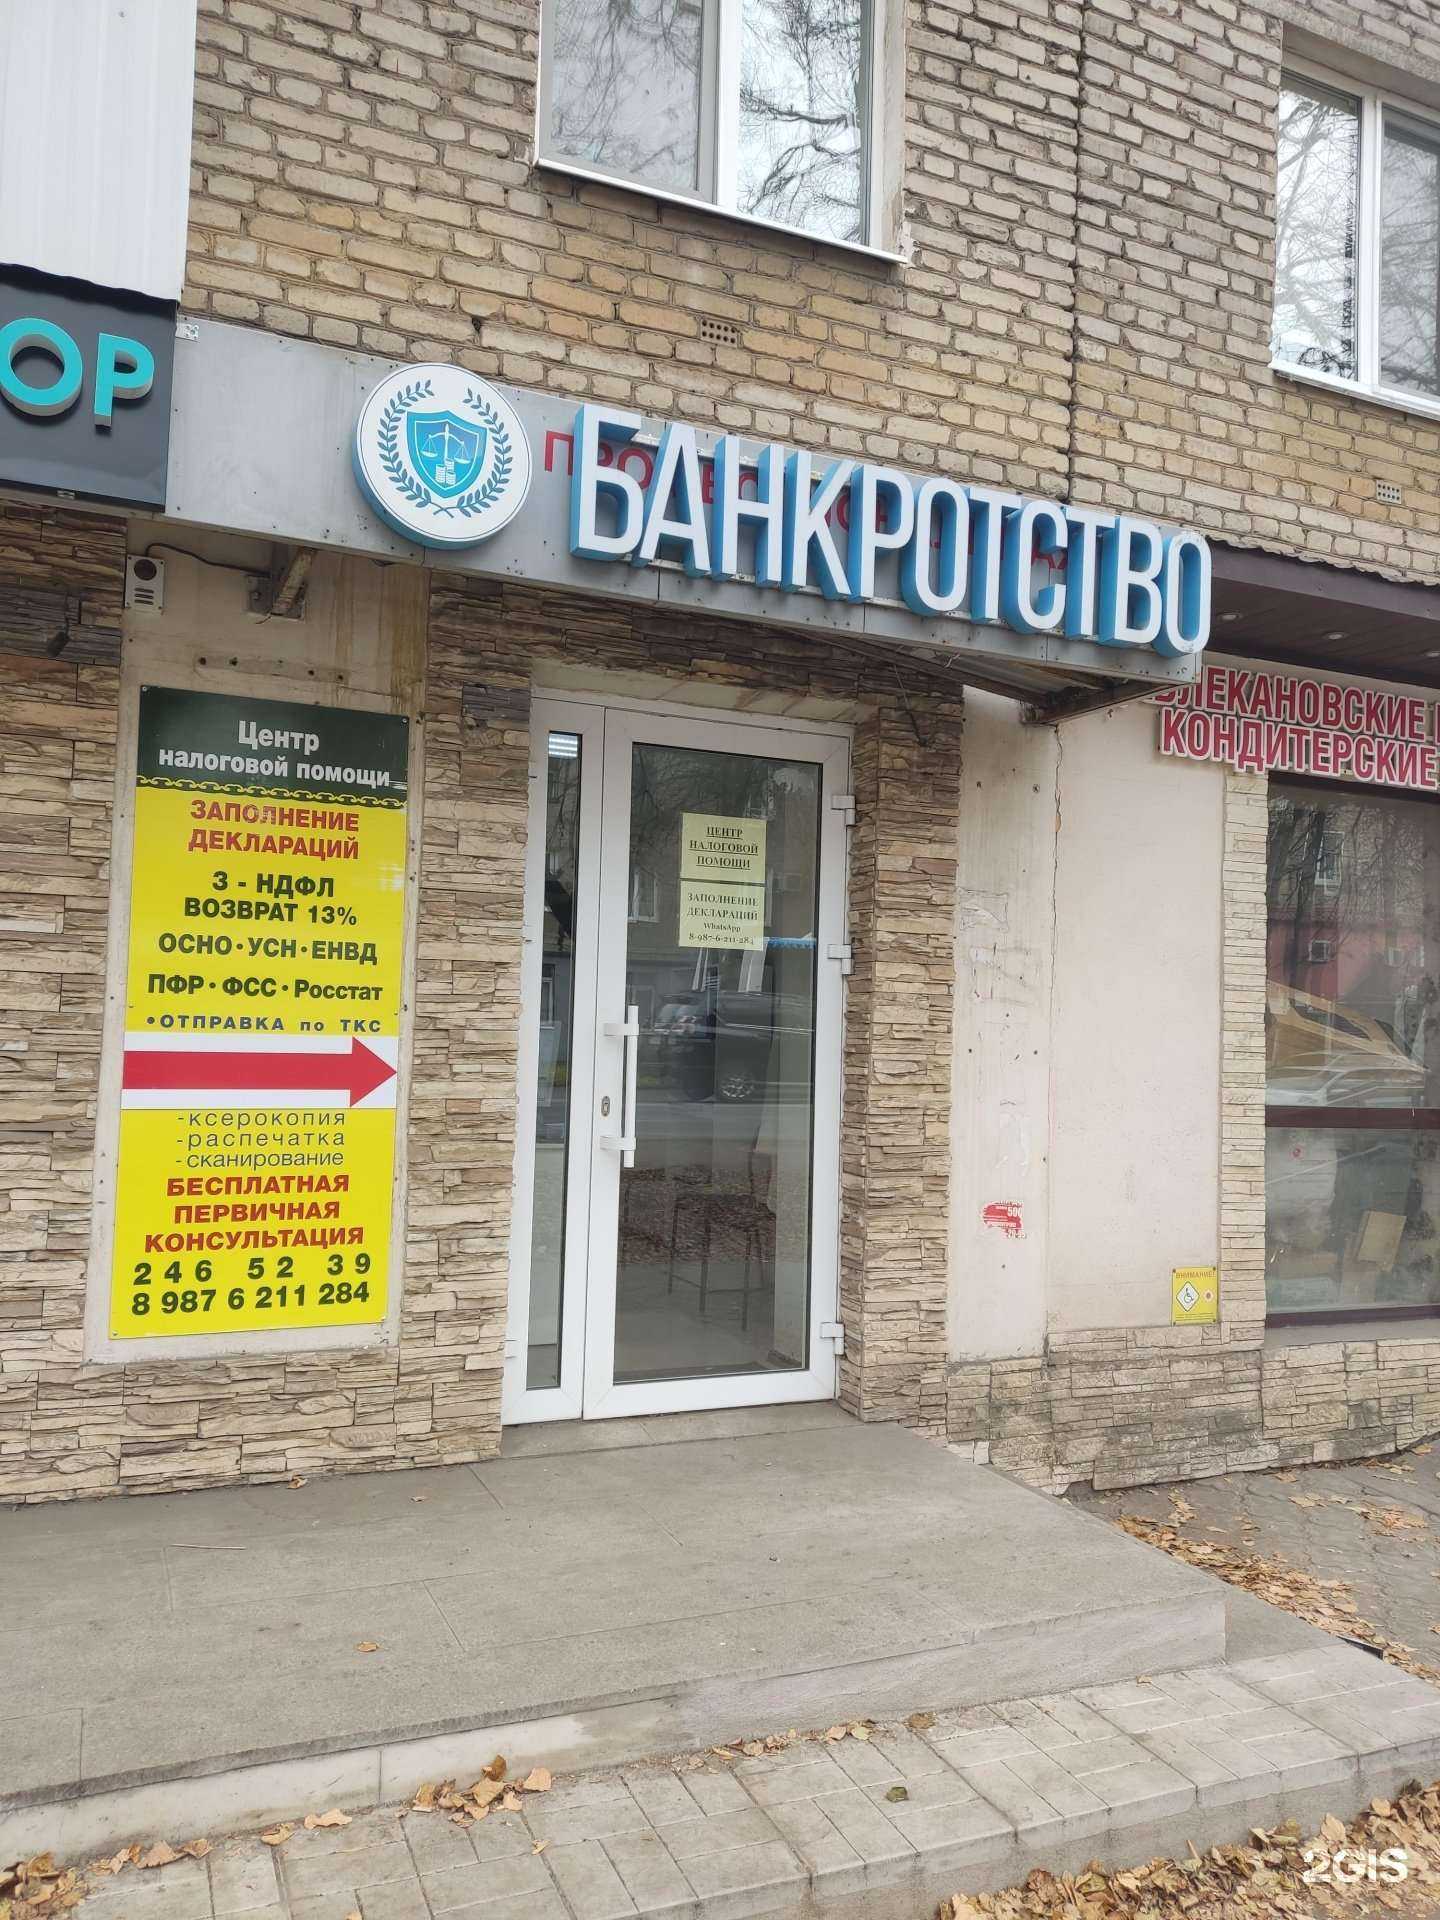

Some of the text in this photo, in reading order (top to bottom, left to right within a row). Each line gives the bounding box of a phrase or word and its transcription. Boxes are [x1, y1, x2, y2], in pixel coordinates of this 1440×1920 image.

[570, 404, 1212, 657] БАНКРОТСТВО
[238, 719, 320, 756] Центр
[1162, 708, 1437, 788] КОНДИТЕРСКИЕ
[158, 749, 391, 788] налоговой помощи
[190, 800, 360, 832] ЗАПОЛНЕНИЕ
[188, 829, 359, 861] ДЕКЛАРАЦИЙ
[706, 826, 743, 840] ЦЕНТР
[689, 840, 759, 856] НАЛОГОВОЙ
[696, 855, 751, 870] ПОМОЩИ
[256, 873, 334, 899] НДФЛ
[184, 898, 357, 925] ВОЗВРАТ 13%
[687, 892, 758, 907] ЗАПОЛНЕНИЕ
[686, 907, 758, 921] ДЕКЛАРАЦИЙ
[300, 1022, 324, 1031] по
[340, 1019, 381, 1032] ТКС
[166, 1174, 350, 1197] БЕСПЛАТНАЯ
[174, 1201, 340, 1225] ПЕРВИЧНАЯ
[144, 1226, 364, 1254] КОНСУЛЬТАЦИЯ
[131, 1281, 370, 1316] 8 987 6 211 284
